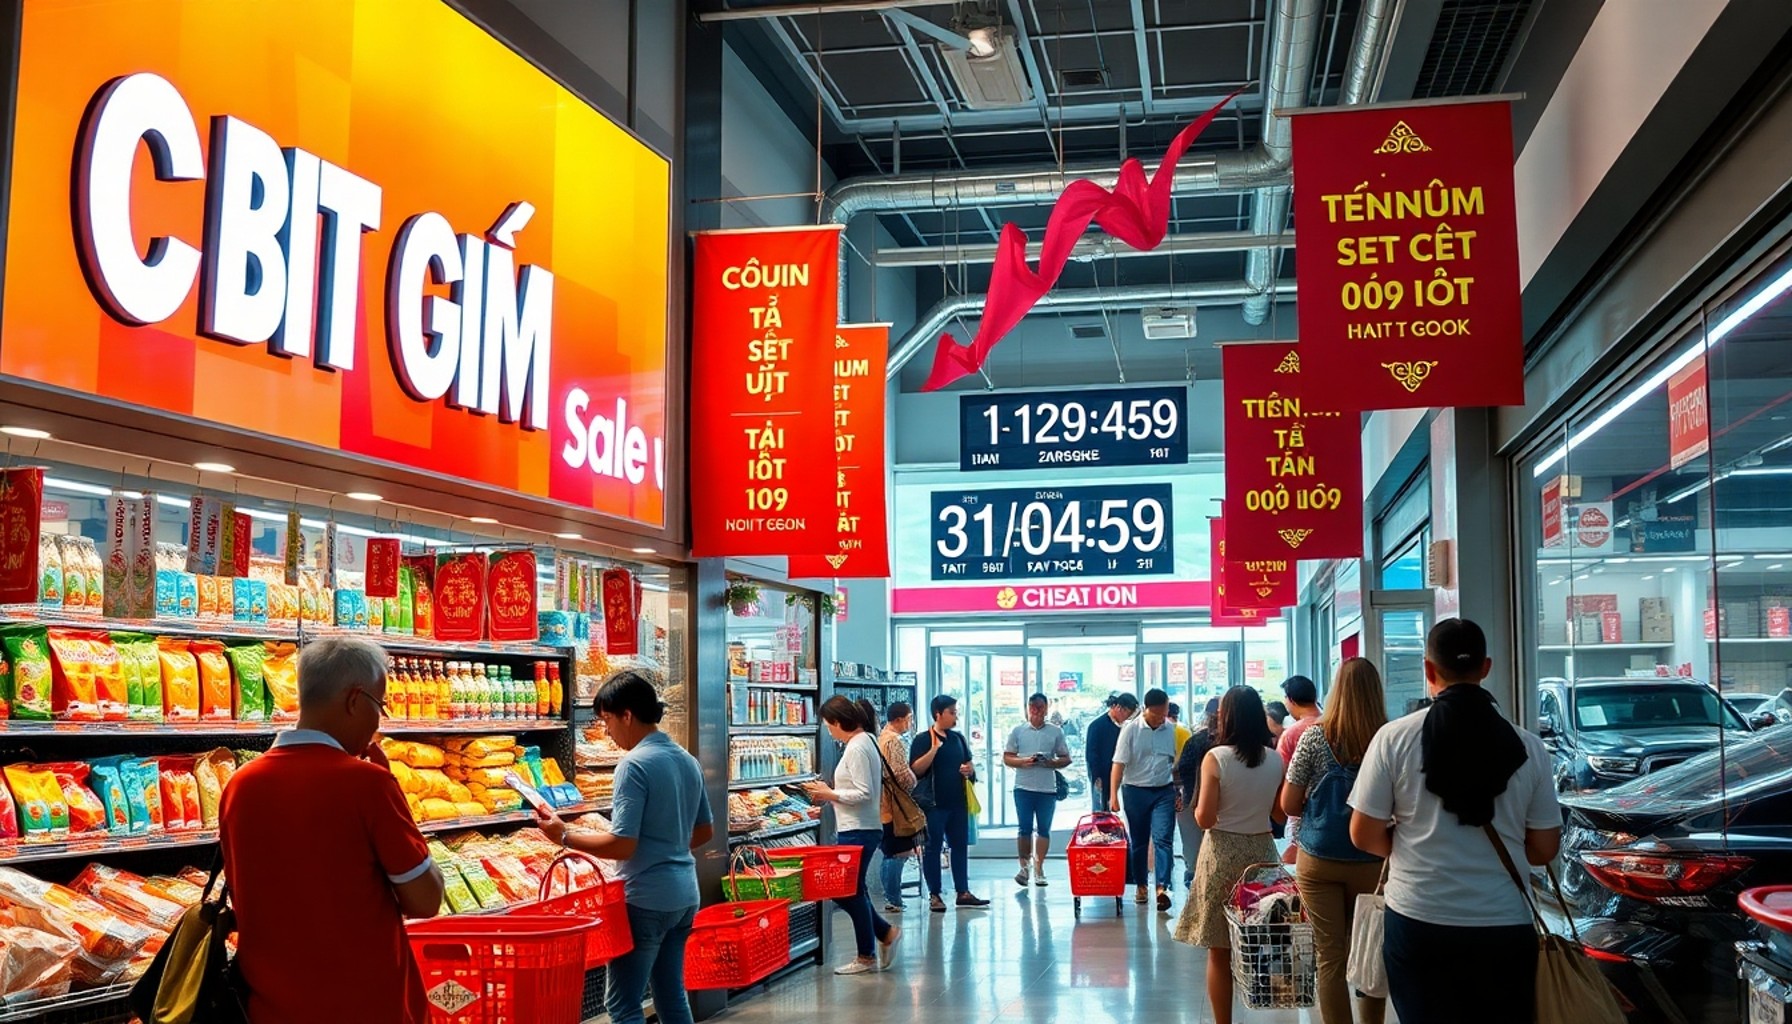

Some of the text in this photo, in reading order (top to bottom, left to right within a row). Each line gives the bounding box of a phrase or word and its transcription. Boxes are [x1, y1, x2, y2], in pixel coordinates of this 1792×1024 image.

[72, 72, 382, 372] CBIT
[1337, 222, 1477, 266] SET CÊT
[722, 257, 809, 290] CÔUIN
[562, 387, 648, 485] Sale
[983, 398, 1178, 445] 1-129:459
[745, 487, 788, 511] 109
[1096, 585, 1138, 606] ION
